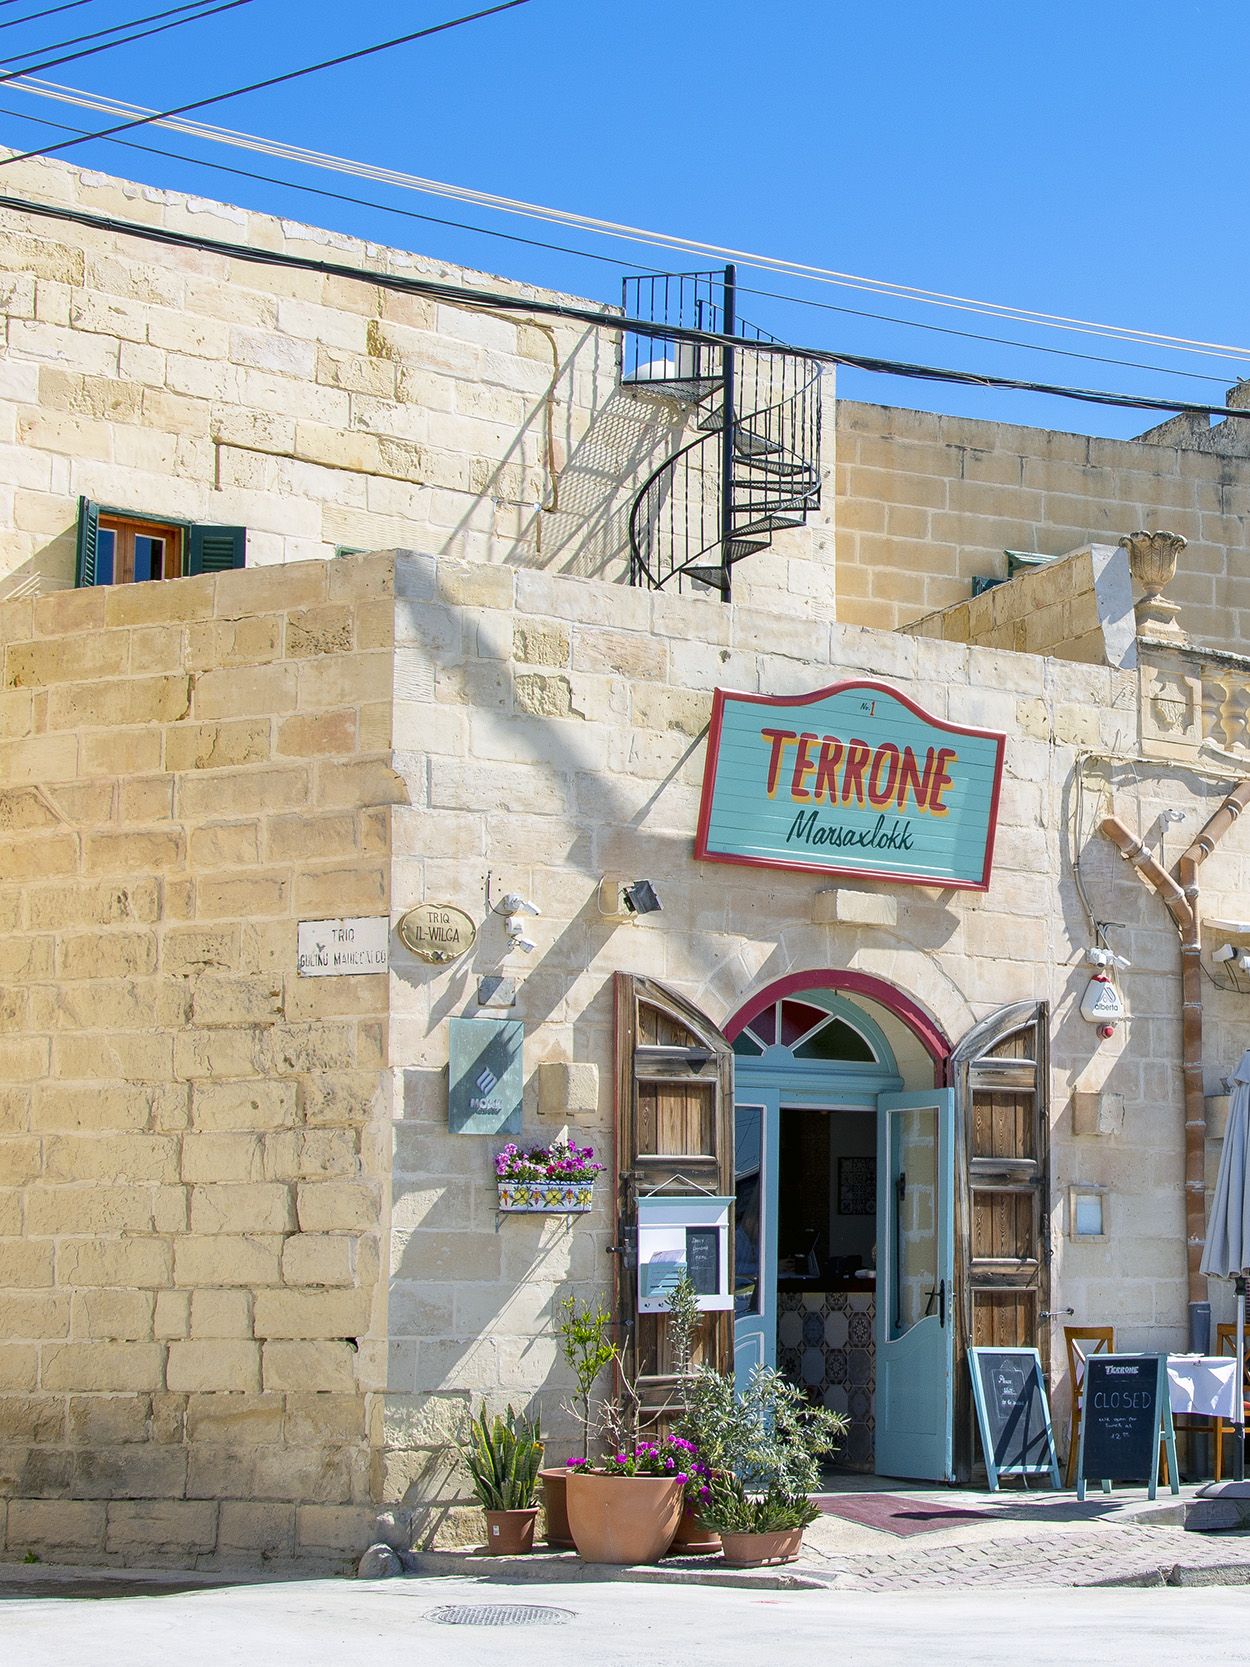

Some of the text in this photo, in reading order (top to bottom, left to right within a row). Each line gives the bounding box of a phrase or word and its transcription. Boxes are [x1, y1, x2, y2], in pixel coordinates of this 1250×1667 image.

[869, 700, 876, 717] 1
[761, 728, 958, 818] TERRONE
[786, 809, 915, 850] Marsaxlokk
[427, 912, 450, 924] TRIQ
[331, 928, 355, 943] TRIQ
[1105, 1365, 1139, 1375] TERRONE
[1094, 1392, 1152, 1409] CLOSED
